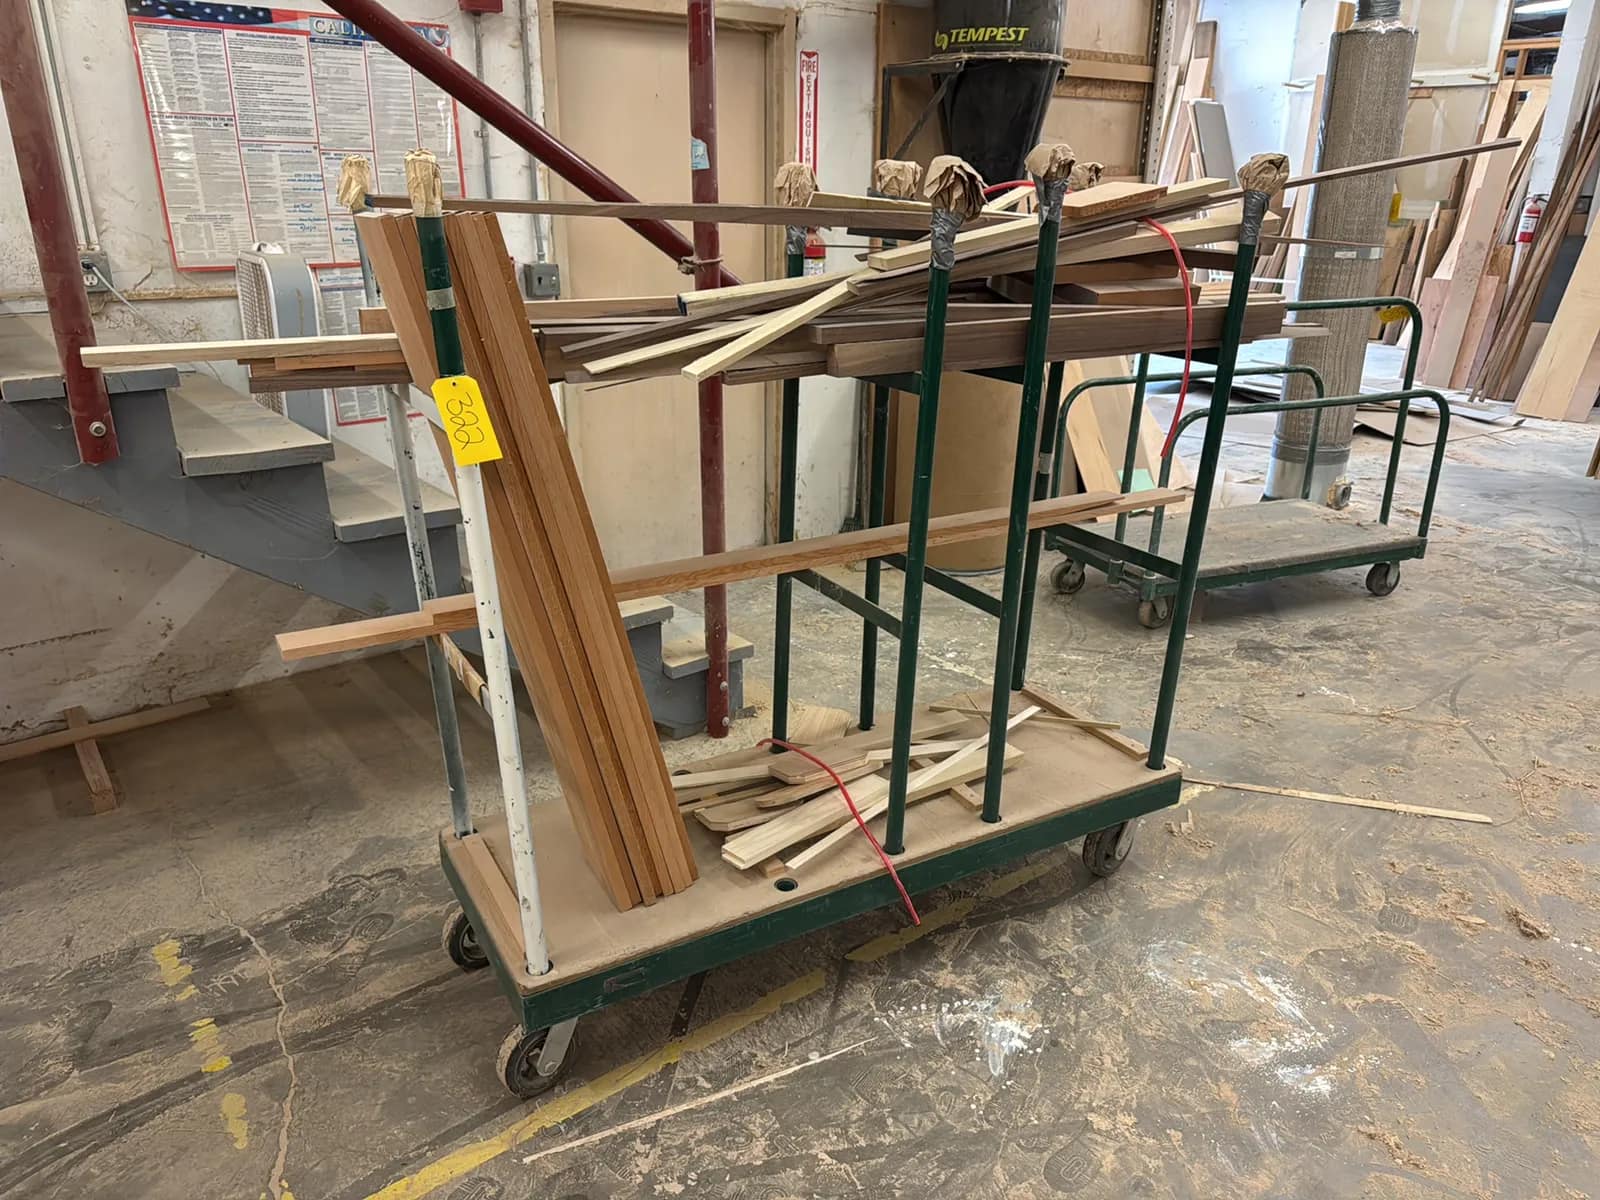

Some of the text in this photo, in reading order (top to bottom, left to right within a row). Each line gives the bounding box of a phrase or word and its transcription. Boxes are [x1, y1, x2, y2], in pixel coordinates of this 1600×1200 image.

[950, 27, 1029, 43] TEMPEST
[801, 60, 817, 73] FIRE
[804, 74, 812, 164] EXTINGUISH
[446, 391, 485, 450] 322
